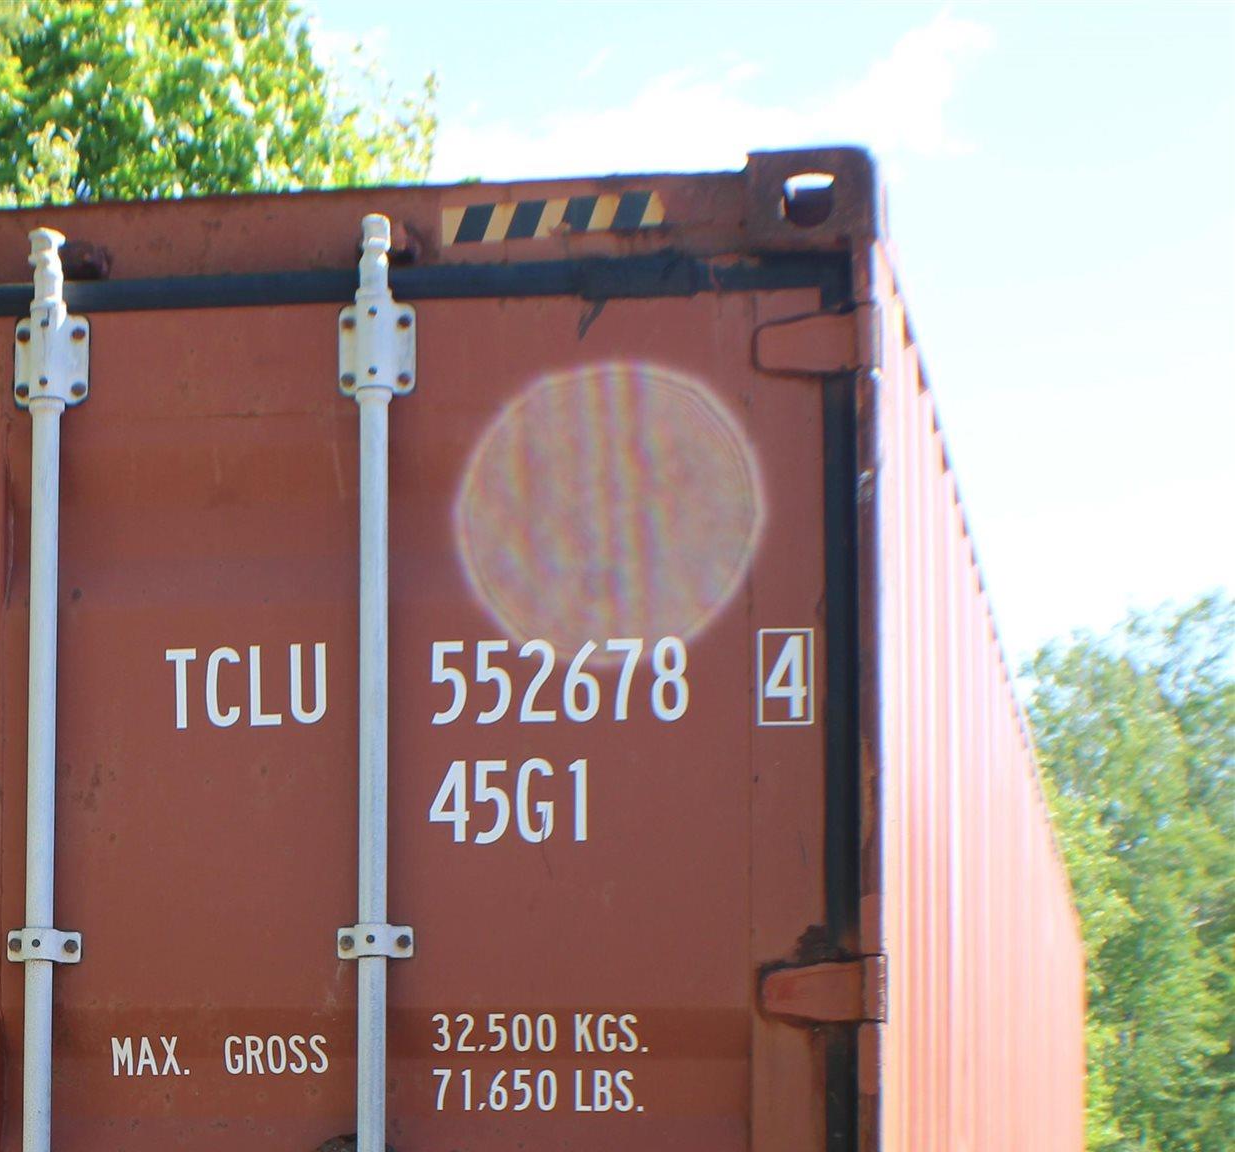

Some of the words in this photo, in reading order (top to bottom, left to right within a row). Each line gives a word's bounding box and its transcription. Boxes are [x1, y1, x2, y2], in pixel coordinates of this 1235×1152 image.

[165, 642, 327, 729] TCLU
[431, 635, 690, 725] 552678
[764, 634, 807, 719] 4
[428, 757, 588, 845] 45G1
[112, 1036, 191, 1077] MAX.
[224, 1034, 330, 1075] GROSS
[573, 1013, 649, 1054] KGS.
[432, 1068, 558, 1113] 71,650
[573, 1070, 646, 1113] LBS.
